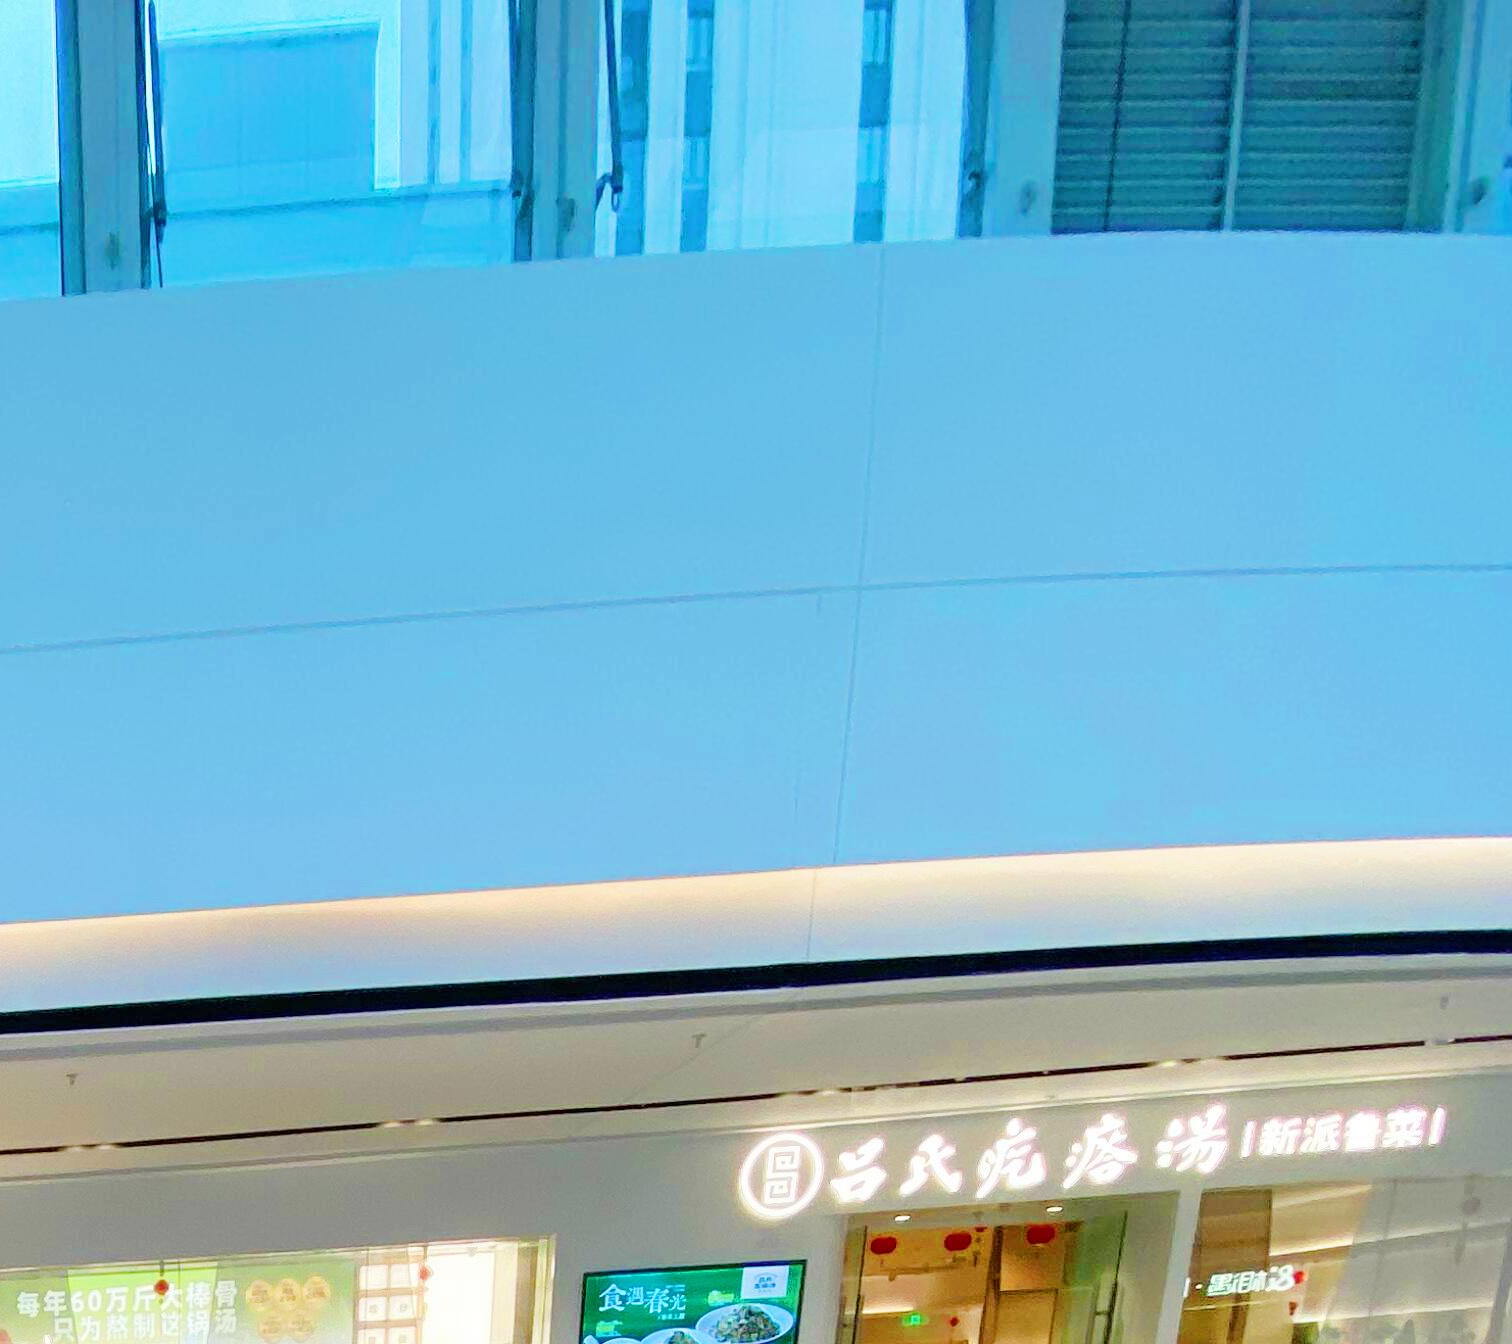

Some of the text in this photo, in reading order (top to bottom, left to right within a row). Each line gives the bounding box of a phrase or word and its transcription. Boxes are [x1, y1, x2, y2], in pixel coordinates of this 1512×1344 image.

[16, 1279, 238, 1319] 每年60万斤大棒骨
[53, 1308, 238, 1343] 只为熬制这锅汤
